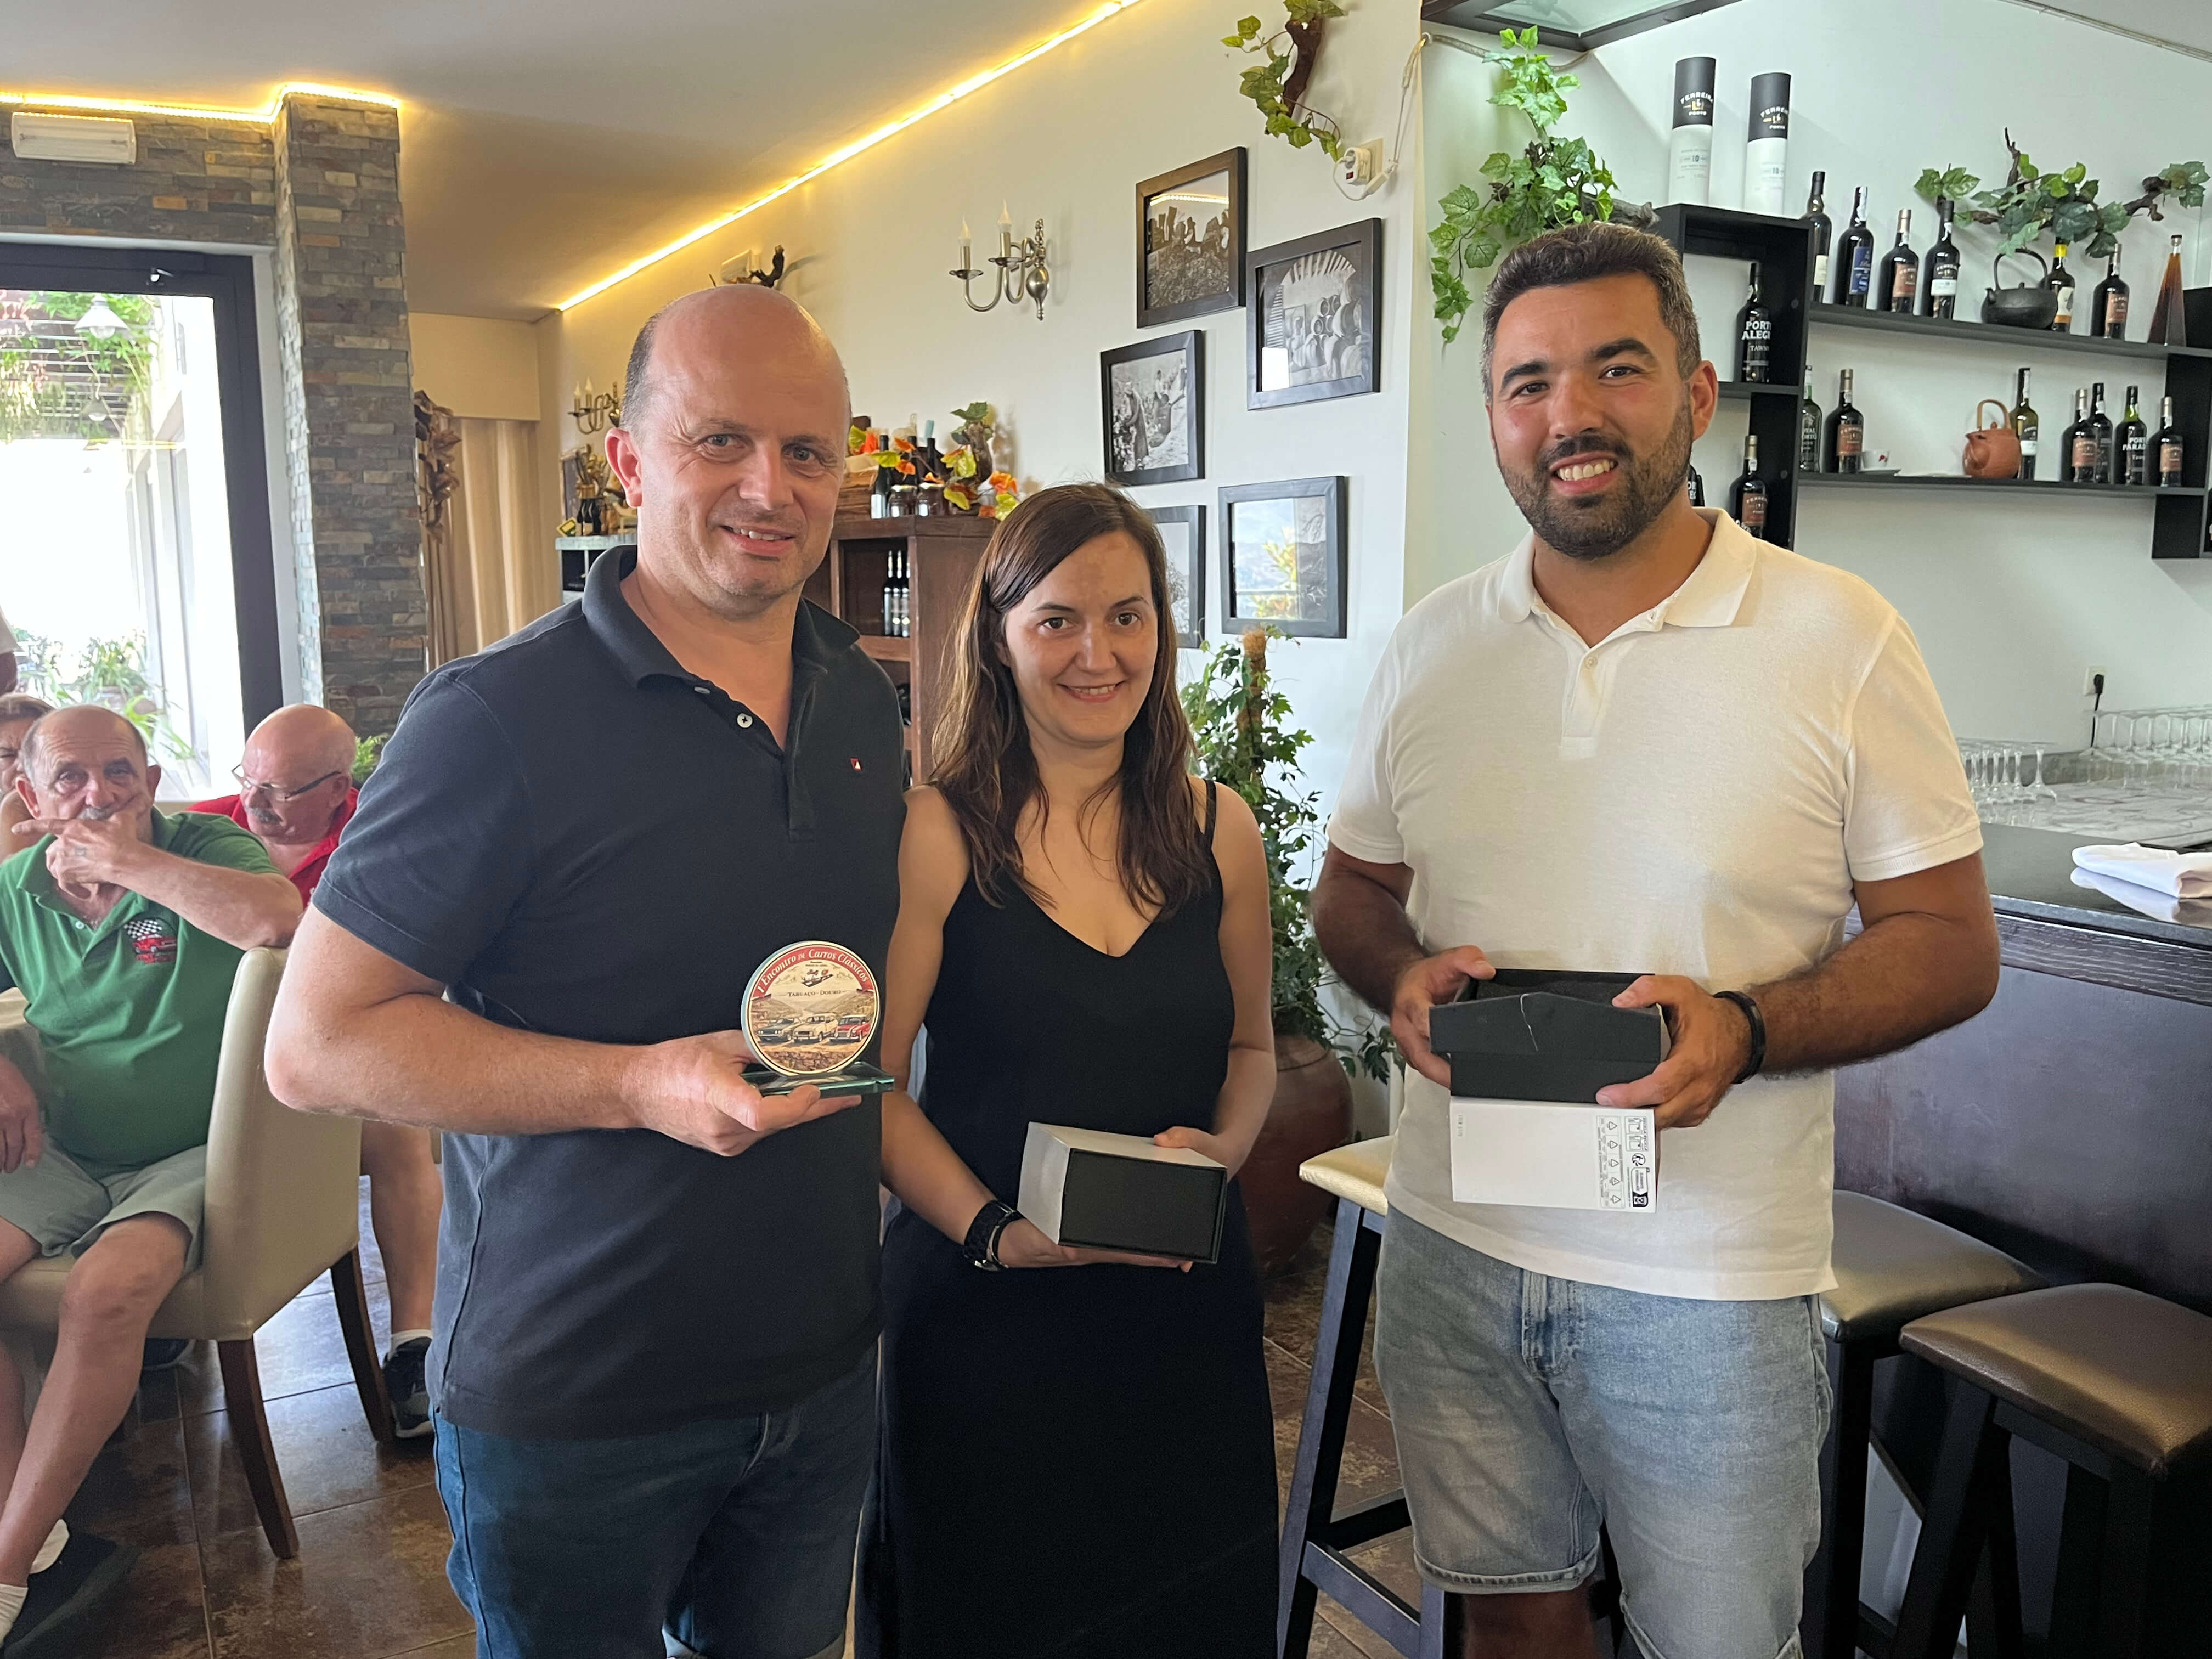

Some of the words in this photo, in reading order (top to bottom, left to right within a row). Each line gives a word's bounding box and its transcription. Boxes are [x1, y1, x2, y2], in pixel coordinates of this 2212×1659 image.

[1746, 321, 1771, 330] PORT
[763, 955, 796, 985] Encontro
[808, 949, 836, 960] Carros
[837, 953, 868, 982] Clássicos
